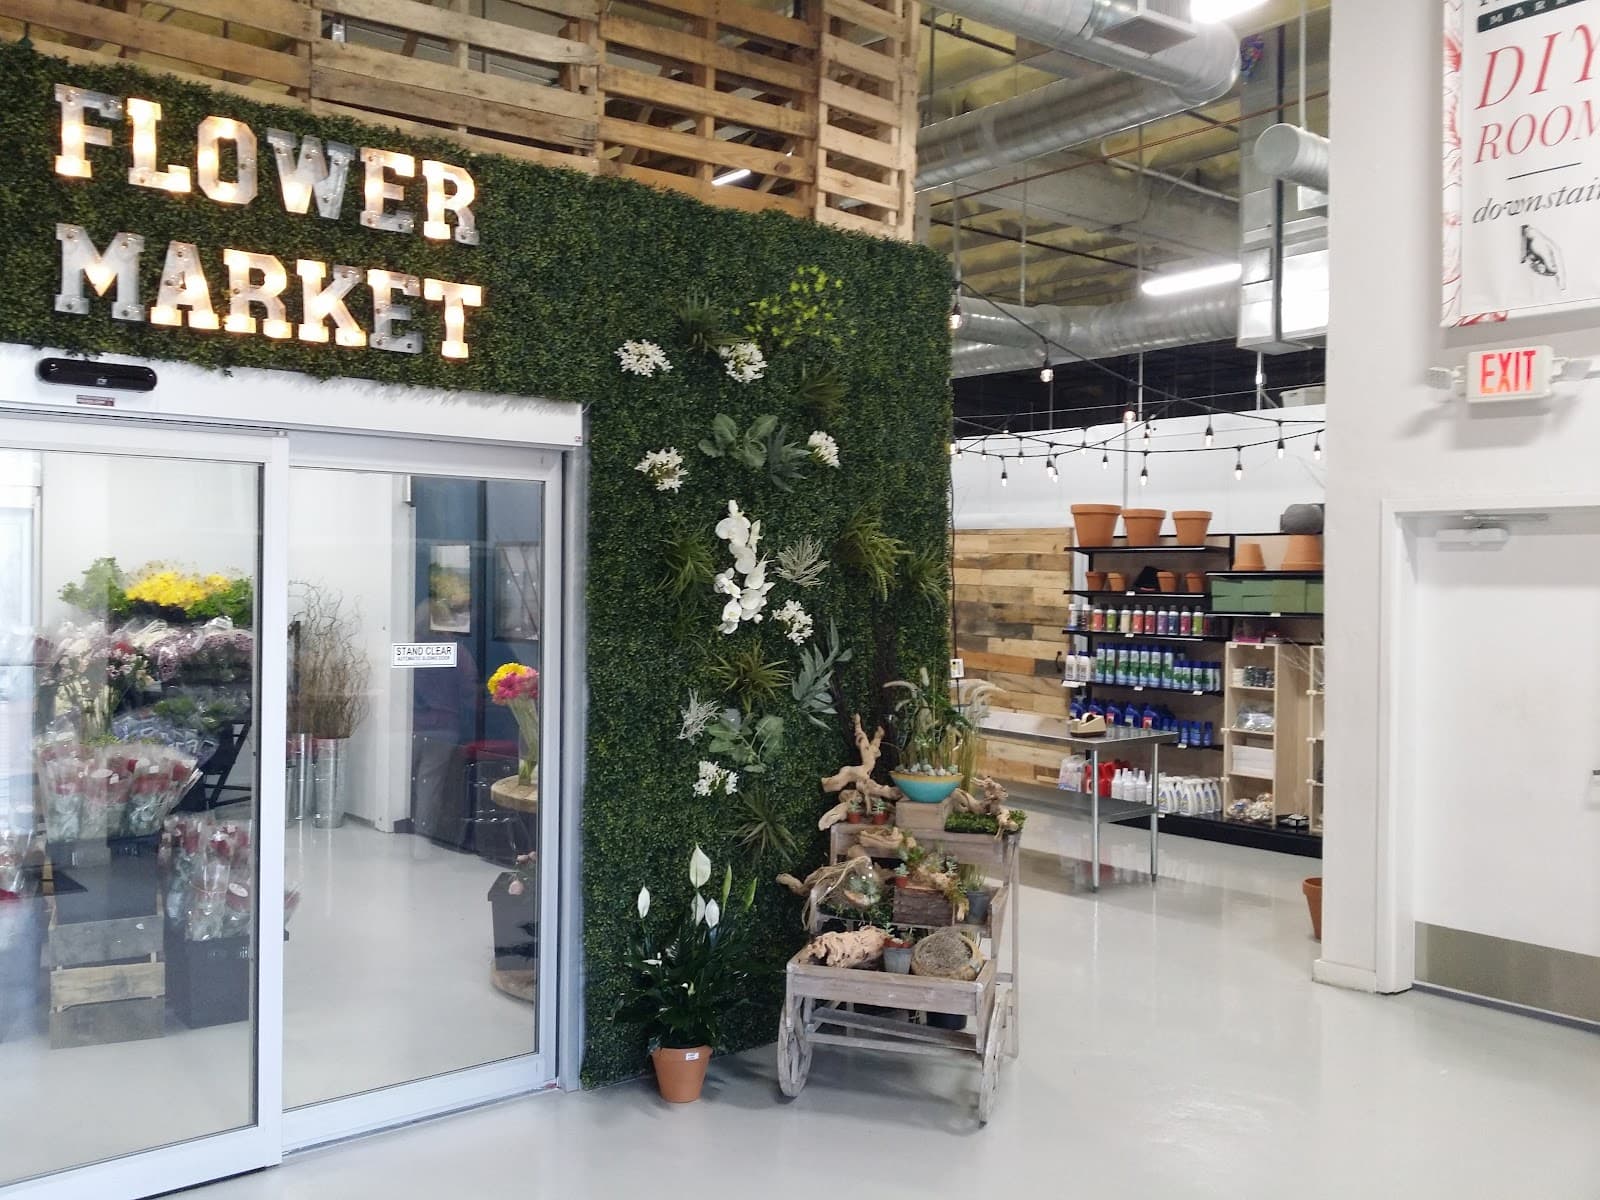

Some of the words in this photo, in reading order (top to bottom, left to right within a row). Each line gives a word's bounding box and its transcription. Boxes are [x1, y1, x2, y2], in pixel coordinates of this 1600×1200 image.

[1474, 24, 1600, 110] DIY
[54, 83, 480, 246] FLOWER
[1472, 176, 1600, 224] downstai
[54, 223, 483, 360] MARKET
[1481, 350, 1536, 393] EXIT
[396, 646, 423, 656] STAND
[425, 646, 452, 656] CLEAR
